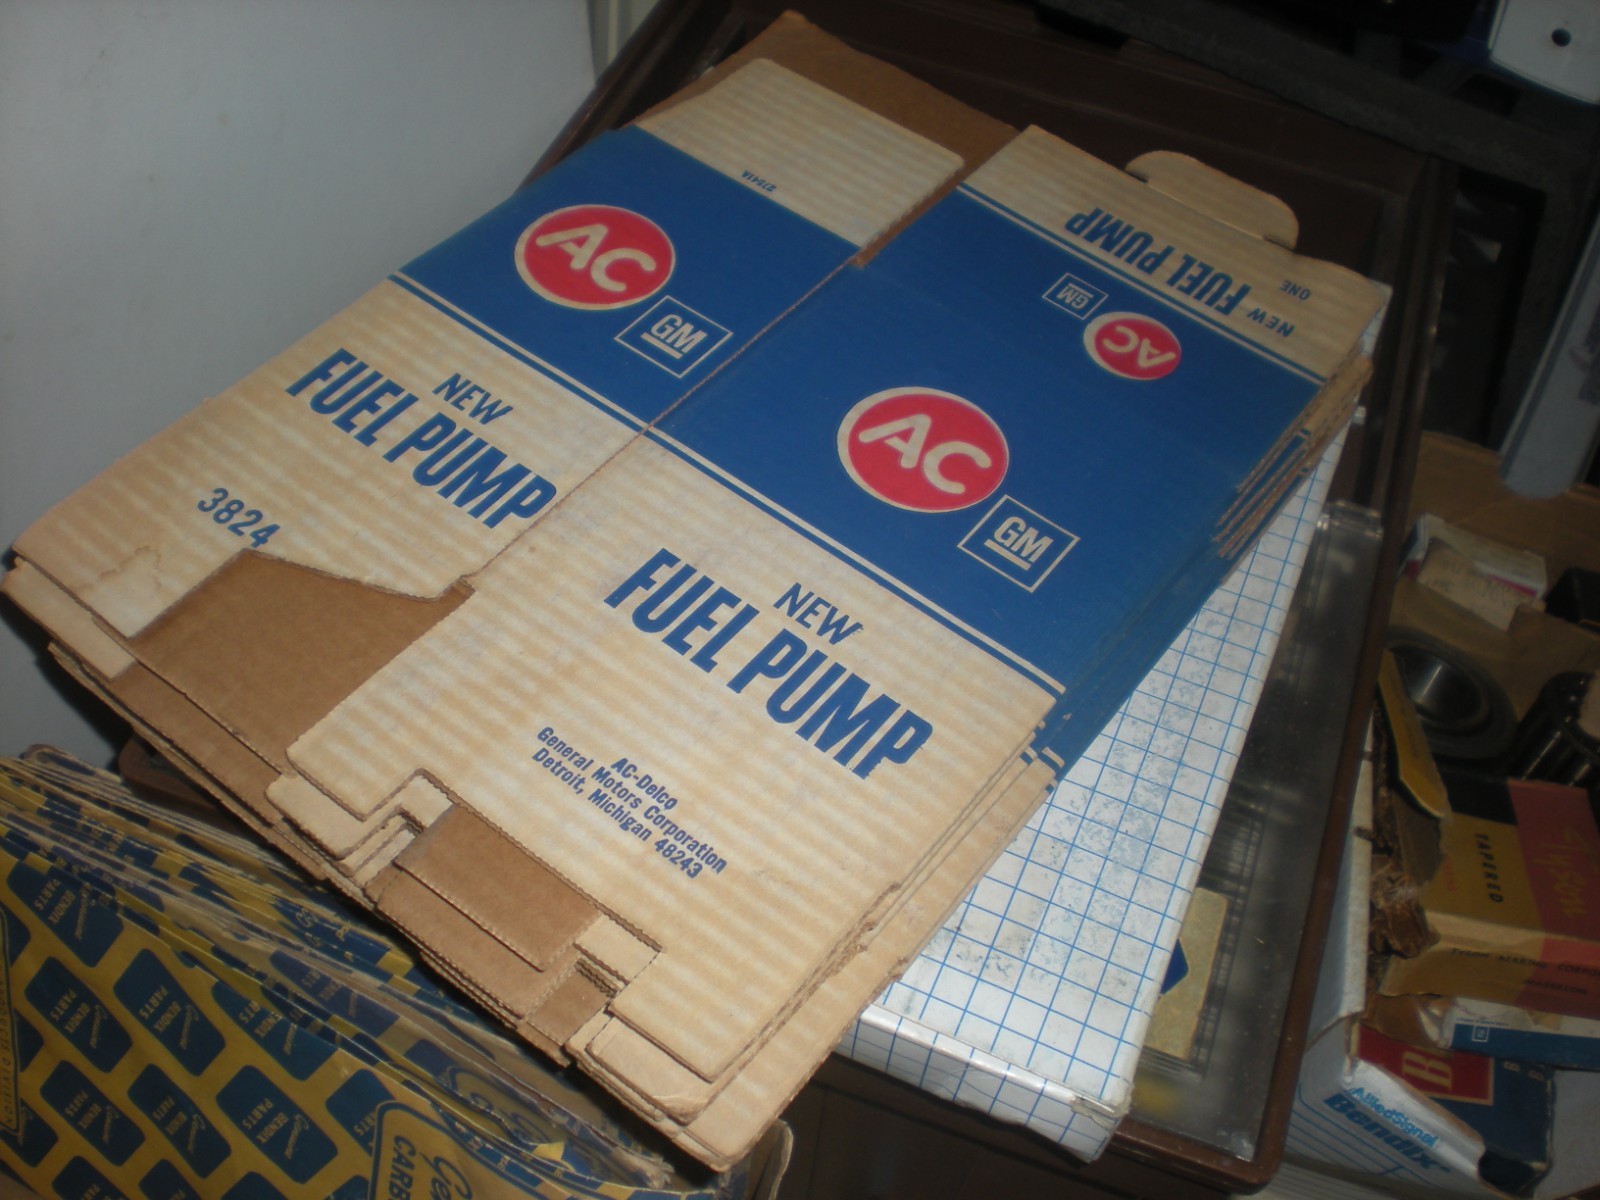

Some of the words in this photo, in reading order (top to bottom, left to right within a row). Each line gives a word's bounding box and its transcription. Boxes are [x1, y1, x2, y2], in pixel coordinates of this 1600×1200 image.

[535, 222, 656, 292] AC
[1064, 207, 1176, 275] PUMP
[1056, 283, 1095, 311] GM
[1166, 252, 1252, 316] FUEL
[1279, 279, 1311, 301] ONE
[649, 314, 709, 354] GM
[1103, 325, 1177, 368] AC
[1246, 307, 1295, 338] NEW
[431, 372, 514, 425] NEW
[284, 347, 420, 447] FUEL
[382, 411, 557, 529] PUMP
[858, 413, 993, 494] AC
[197, 487, 281, 548] 3824
[993, 515, 1055, 564] GM
[772, 582, 864, 645] NEW
[603, 547, 760, 674] FUEL
[726, 627, 934, 780] PUMP
[537, 726, 594, 771] General
[591, 766, 643, 810] Motors
[643, 805, 727, 875] Corporation
[610, 757, 678, 811] AC-Delco
[531, 747, 586, 795] Detroit,
[587, 788, 653, 842] Michigan
[654, 838, 703, 879] 48243
[1474, 832, 1504, 904] TAPERED
[51, 988, 77, 1022] PARTS
[64, 1002, 91, 1034] BENDIX
[139, 985, 169, 1020] PARTS
[153, 1001, 181, 1034] BENDIX
[64, 1089, 89, 1117] PARTS
[241, 1097, 274, 1130] PARTS
[256, 1112, 290, 1144] BENDIX
[1348, 1086, 1439, 1148] AlliedSignal
[1323, 1092, 1440, 1169] Bendix
